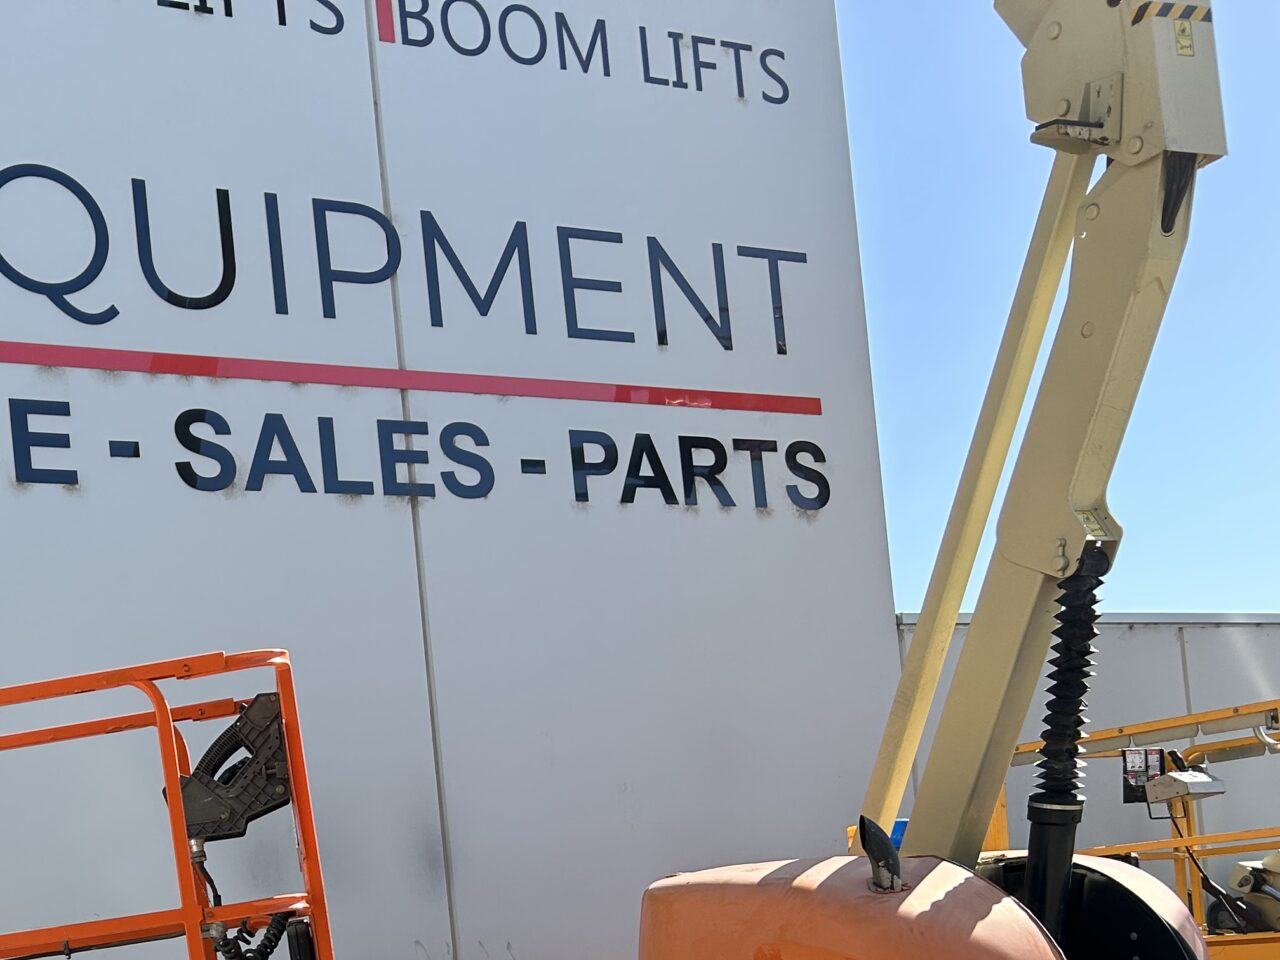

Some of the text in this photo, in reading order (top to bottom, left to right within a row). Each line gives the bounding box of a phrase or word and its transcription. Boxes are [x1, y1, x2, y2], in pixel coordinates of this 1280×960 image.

[399, 0, 611, 77] BOOM
[639, 25, 791, 105] LIFTS
[174, 408, 495, 499] SALES
[569, 429, 831, 511] PARTS
